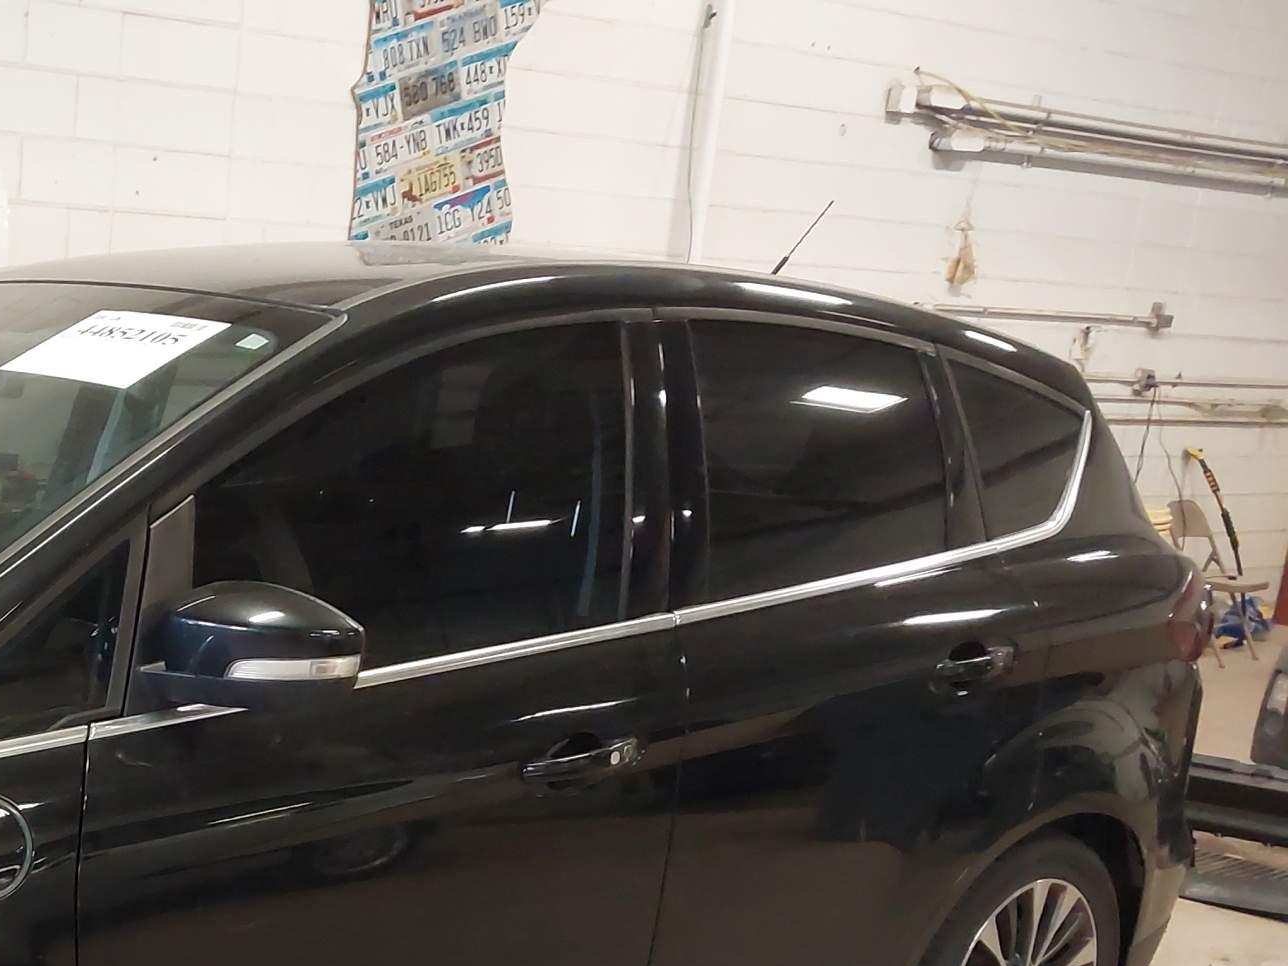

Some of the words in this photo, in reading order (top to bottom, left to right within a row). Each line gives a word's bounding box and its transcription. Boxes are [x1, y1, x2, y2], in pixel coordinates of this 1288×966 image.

[441, 26, 467, 52] 524
[382, 43, 405, 69] 808
[465, 61, 488, 86] 448
[375, 129, 428, 166] 584-YNB
[389, 214, 414, 229] TEXAS
[77, 324, 188, 345] 44852105
